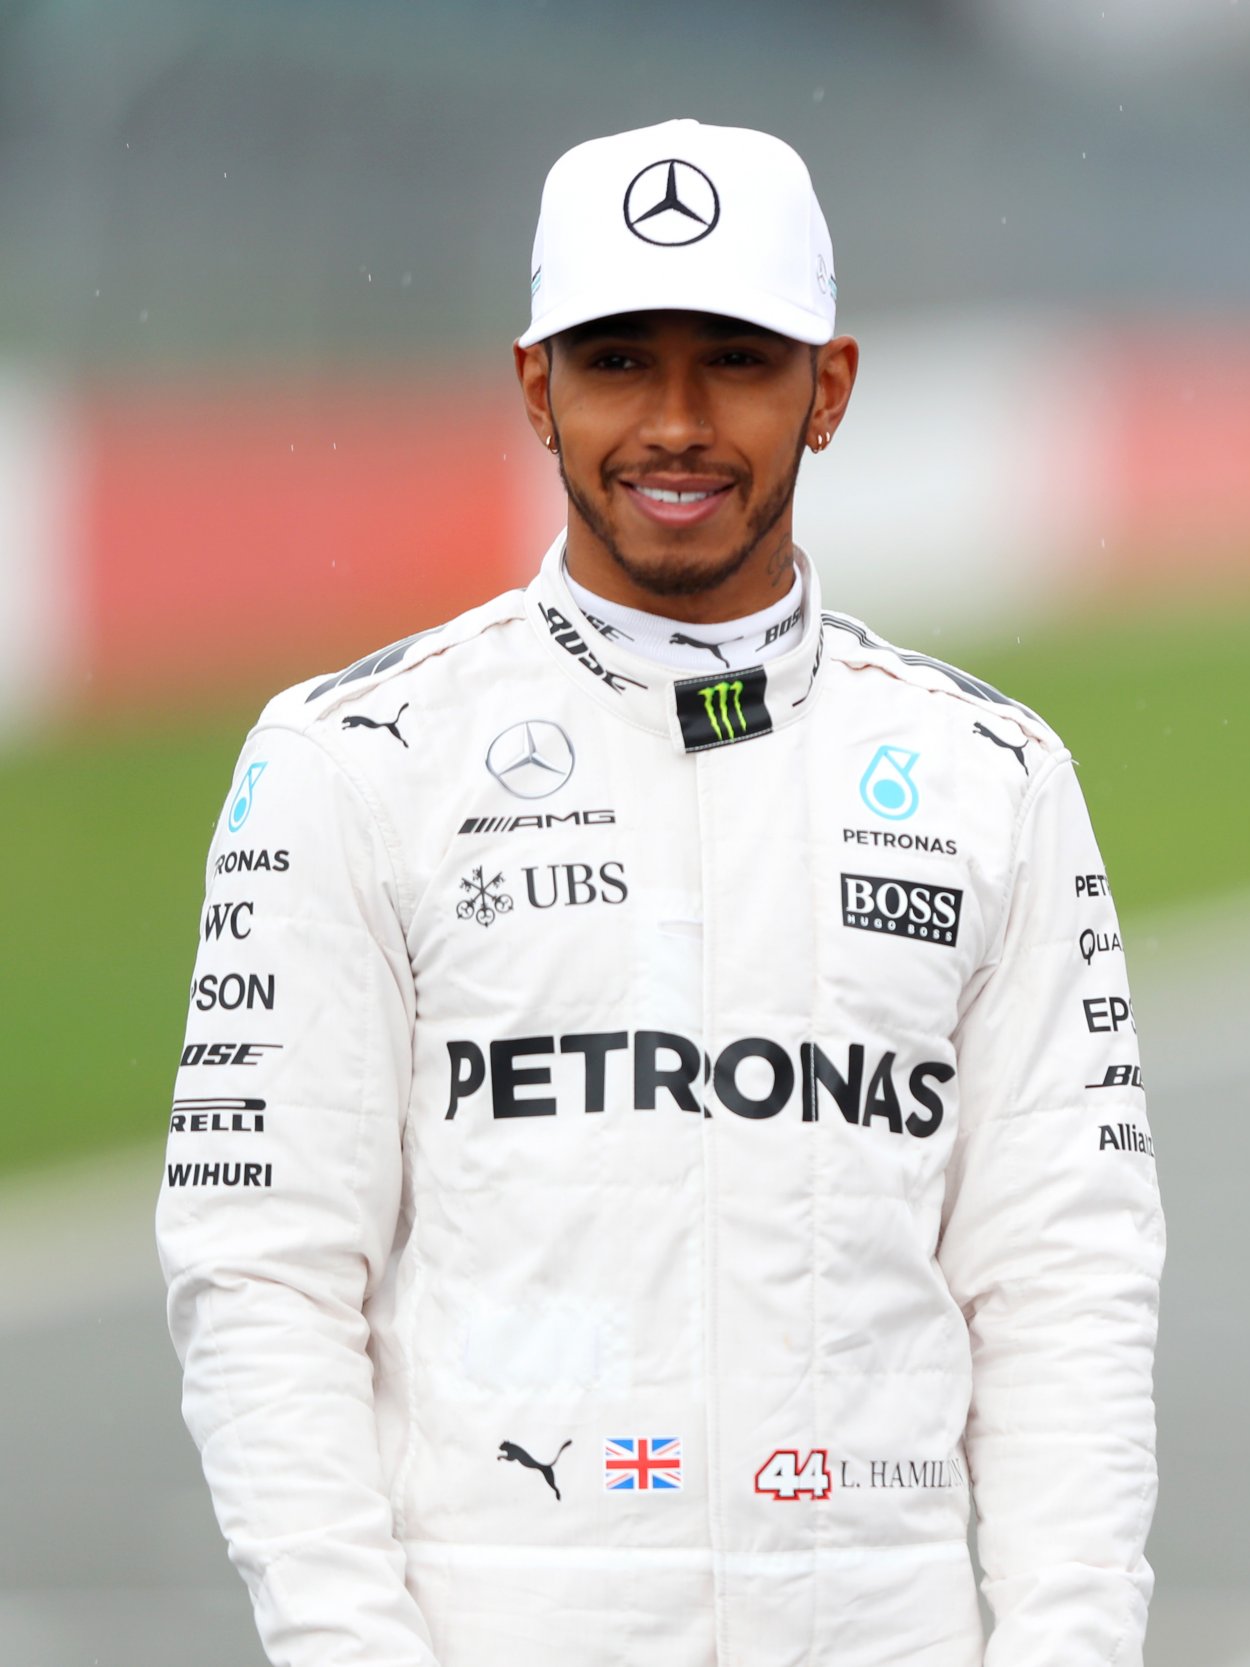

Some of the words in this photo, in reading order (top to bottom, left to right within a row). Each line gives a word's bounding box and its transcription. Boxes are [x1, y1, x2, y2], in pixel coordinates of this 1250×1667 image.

[538, 602, 648, 695] BOSE
[510, 811, 616, 832] AMG
[843, 828, 957, 855] PETRONAS
[521, 862, 628, 909] UBS
[844, 877, 956, 929] BOSS
[847, 914, 896, 931] HUGO
[907, 924, 953, 942] BOSS
[445, 1030, 957, 1138] PETRONAS
[168, 1163, 272, 1187] WIHURI
[755, 1449, 832, 1501] 44
